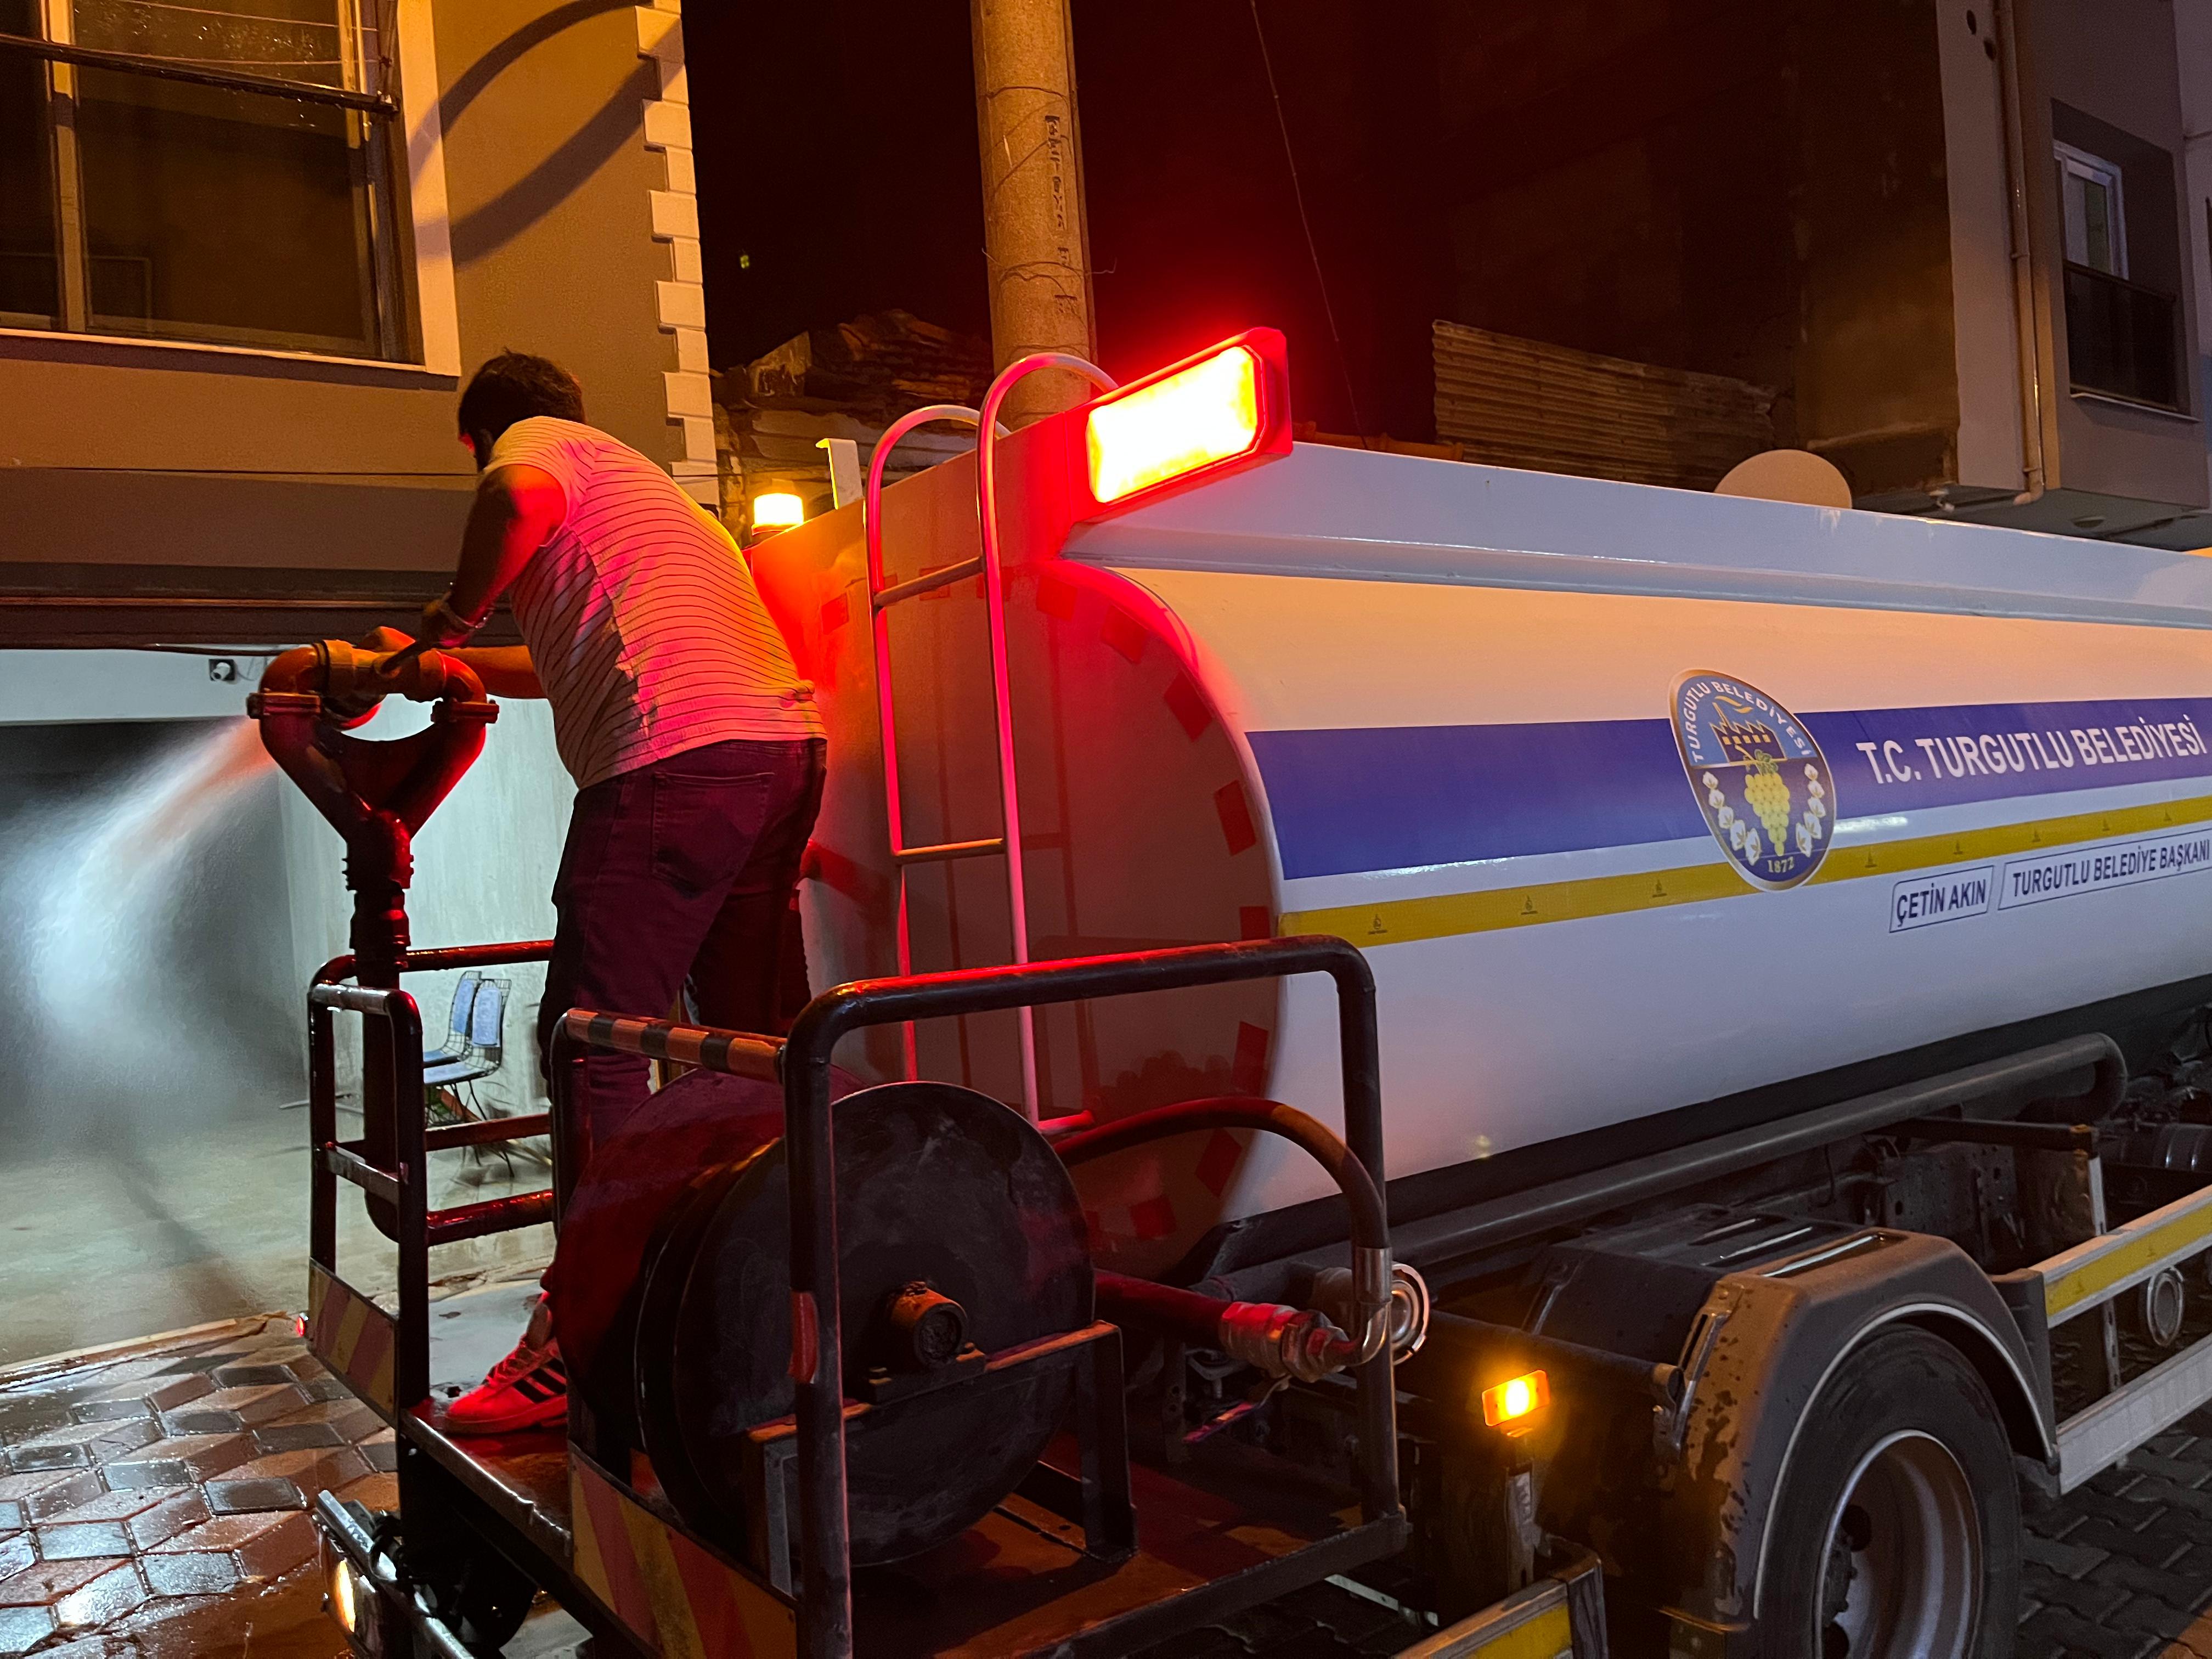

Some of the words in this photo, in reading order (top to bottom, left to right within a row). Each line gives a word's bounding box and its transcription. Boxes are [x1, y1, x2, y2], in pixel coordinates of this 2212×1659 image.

[1683, 682, 1711, 763] TURGUTLU
[1856, 740, 1922, 784] T.C.
[1915, 731, 2074, 780] TURGUTLU
[2069, 714, 2208, 766] BELEDİYESİ
[2013, 860, 2091, 897] TURGUTLU
[2094, 845, 2157, 882] BELEDİYE
[2159, 839, 2210, 871] BAŞKANI
[1897, 883, 1945, 928] ÇETİN
[1948, 879, 1986, 911] AKIN
